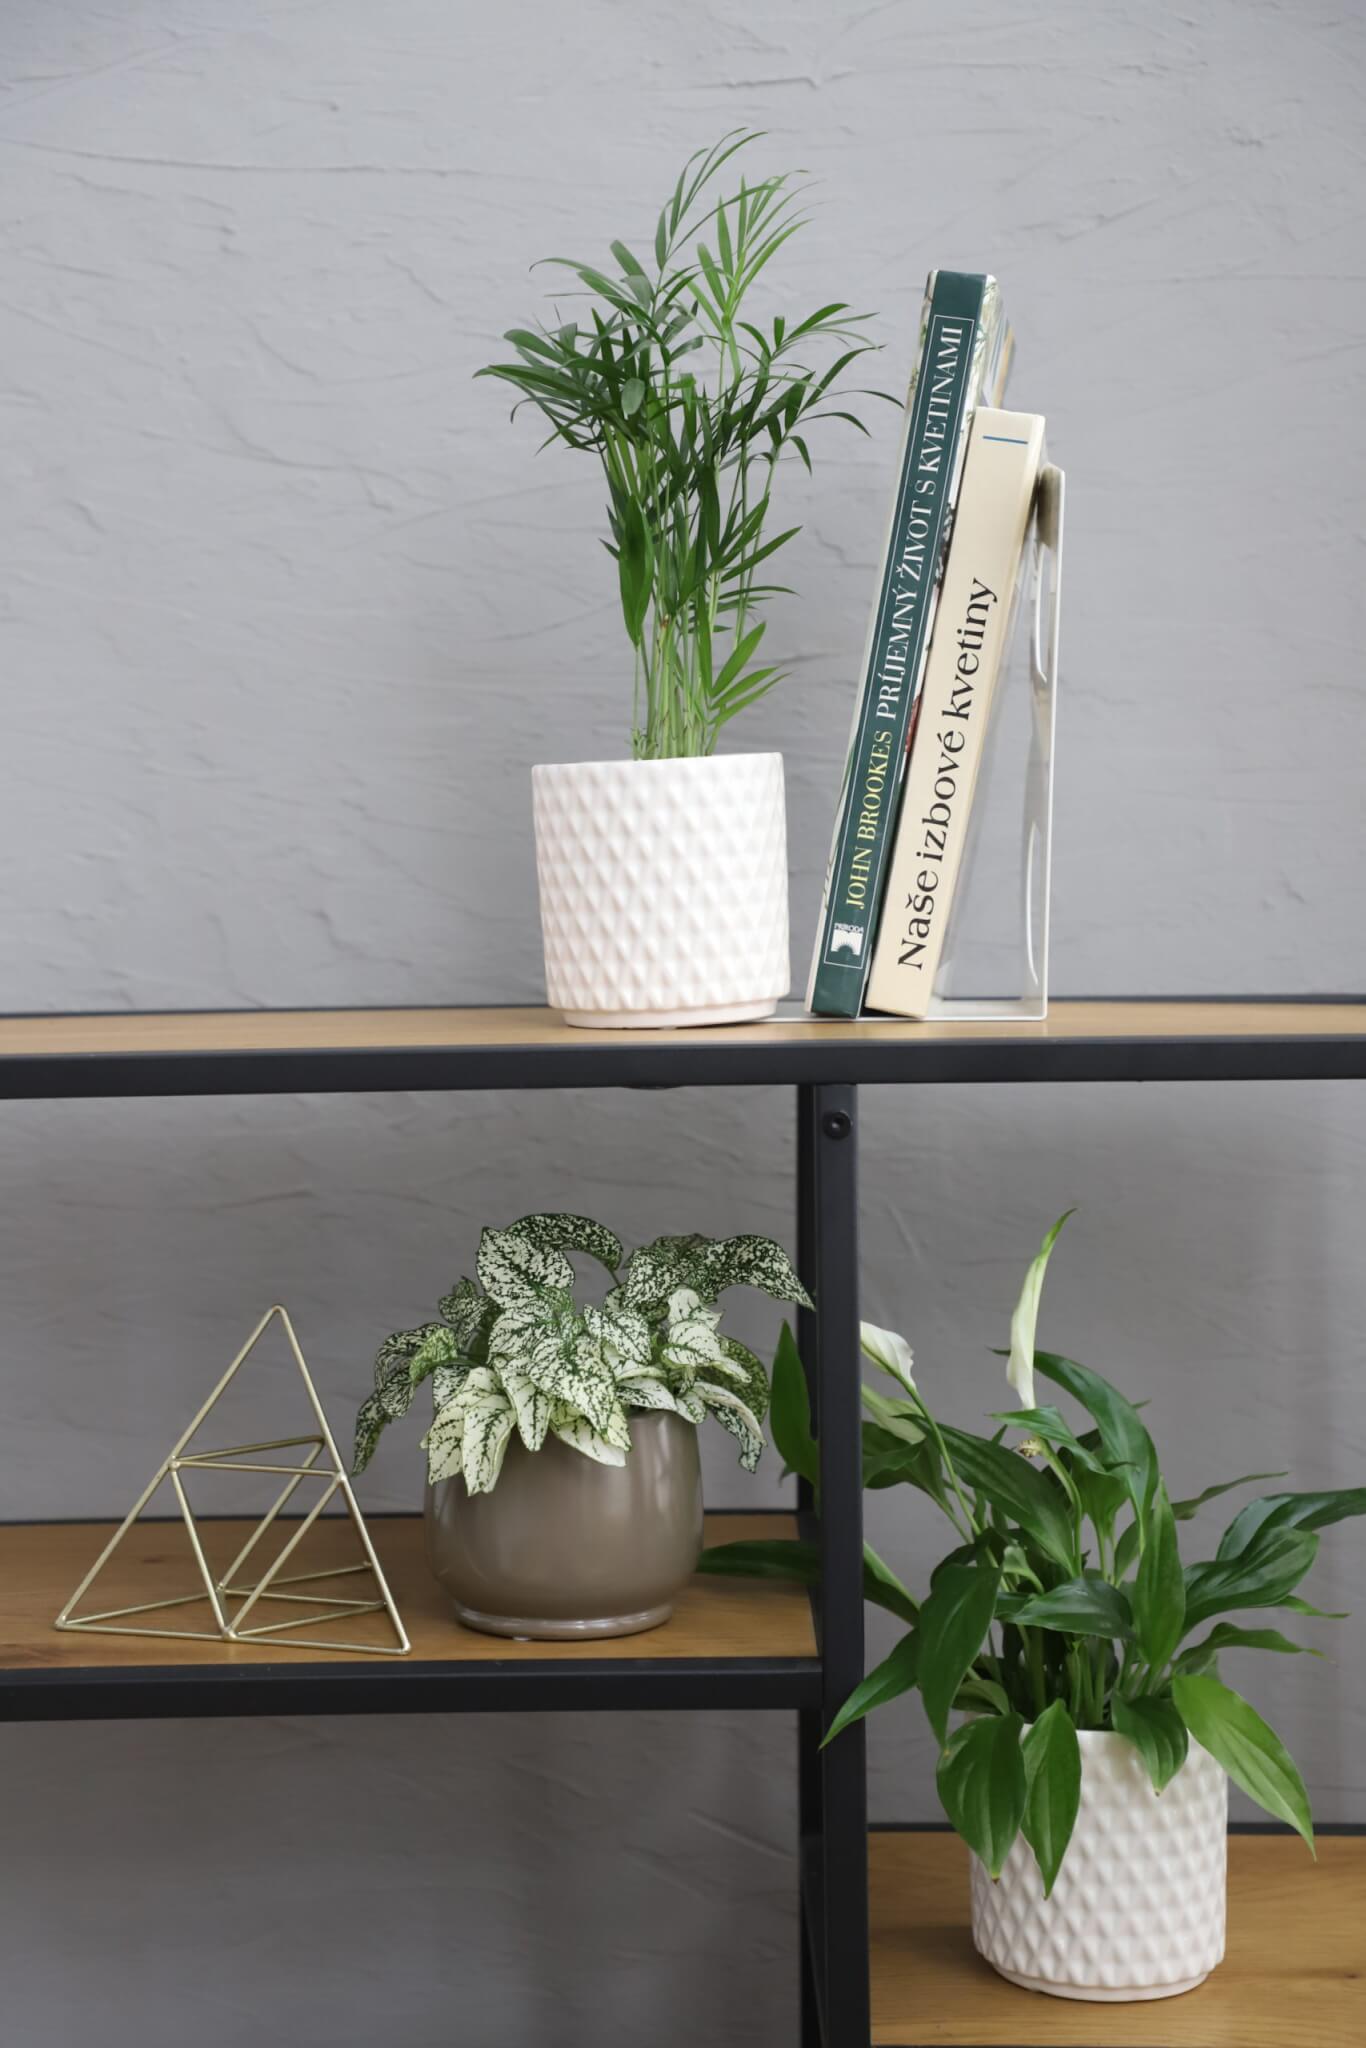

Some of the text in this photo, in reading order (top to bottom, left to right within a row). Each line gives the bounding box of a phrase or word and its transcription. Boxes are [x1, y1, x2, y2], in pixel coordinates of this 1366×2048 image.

[846, 325, 963, 910] JOHN BROOKES PRÍJEMNÝ ŽIVOT S KVETINAMI
[897, 577, 998, 971] Naše izbové kvetiny
